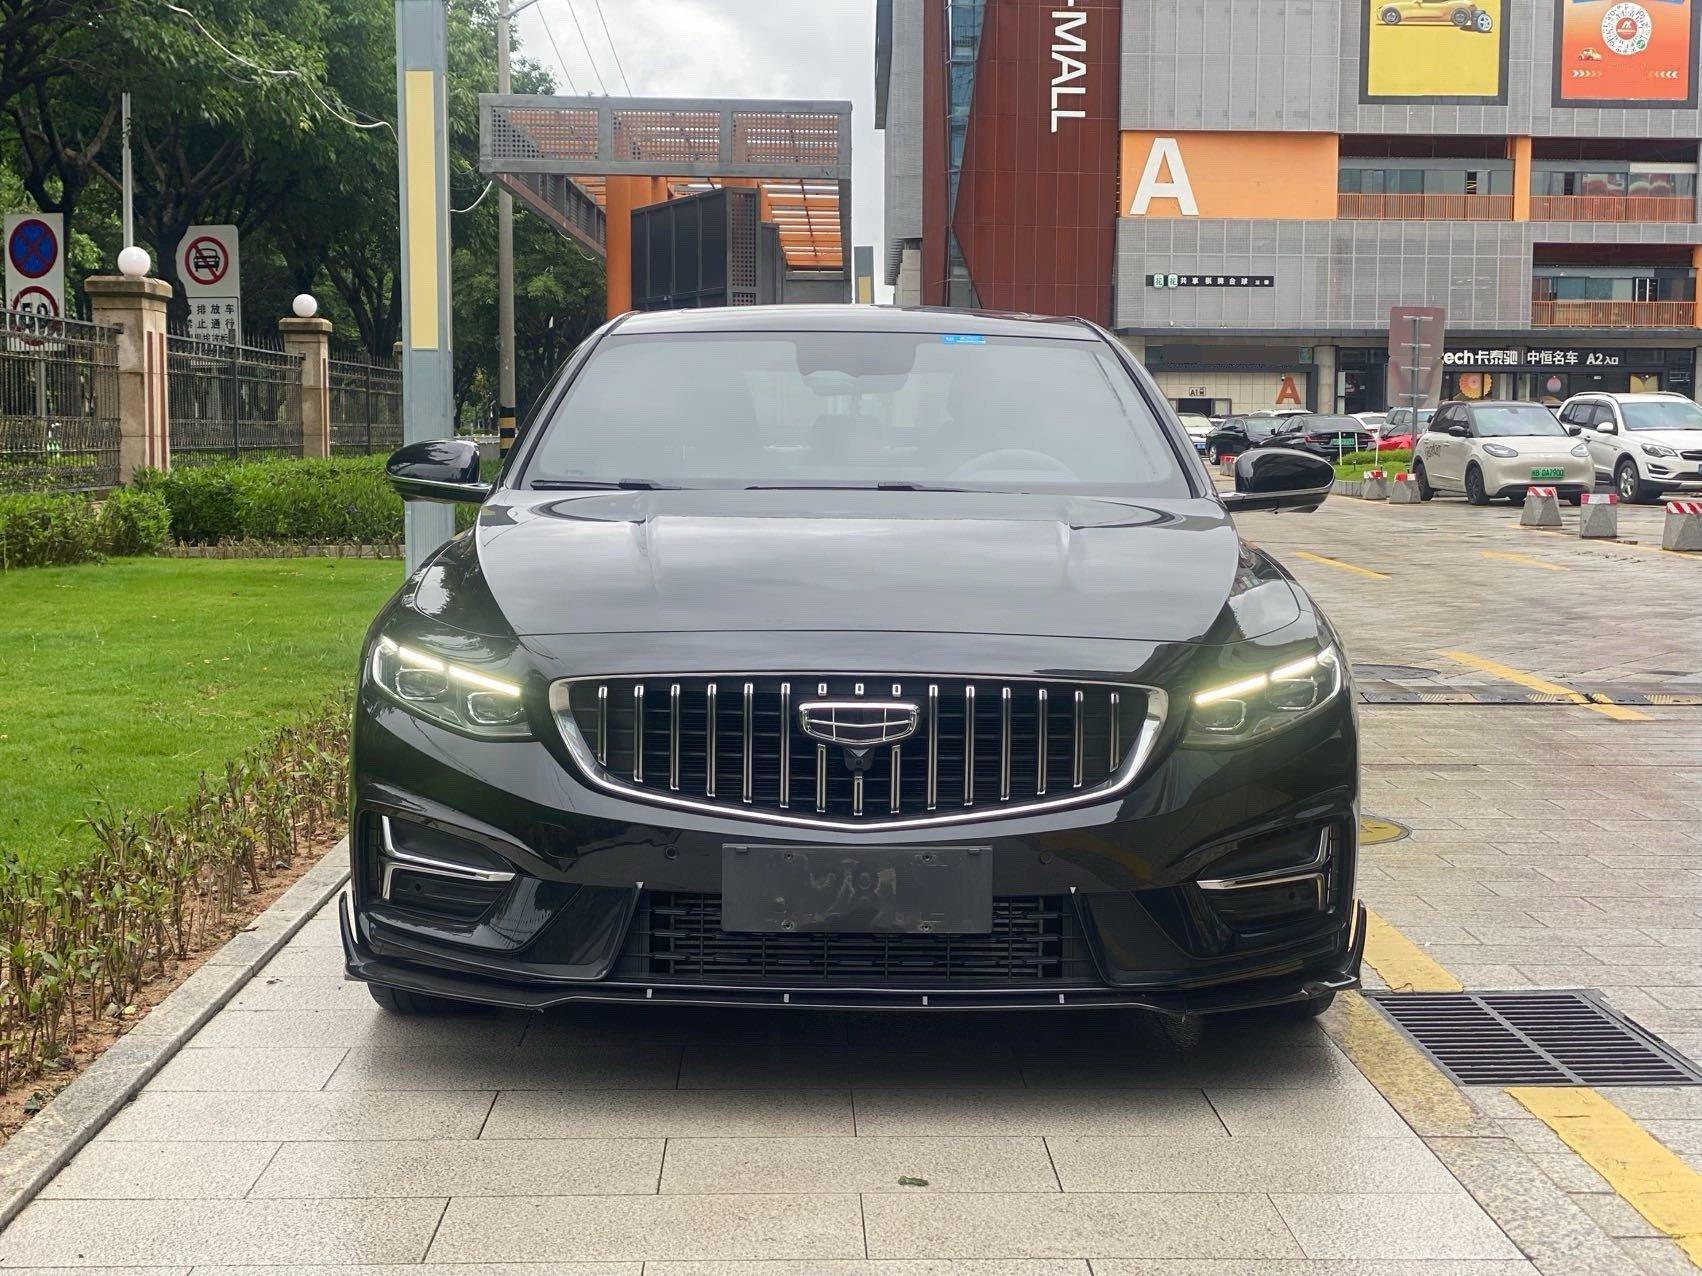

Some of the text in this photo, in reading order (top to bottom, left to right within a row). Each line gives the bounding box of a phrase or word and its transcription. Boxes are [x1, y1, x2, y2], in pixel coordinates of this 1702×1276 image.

[1129, 137, 1200, 216] A
[1527, 350, 1579, 365] 中恒名车
[1275, 376, 1301, 405] A
